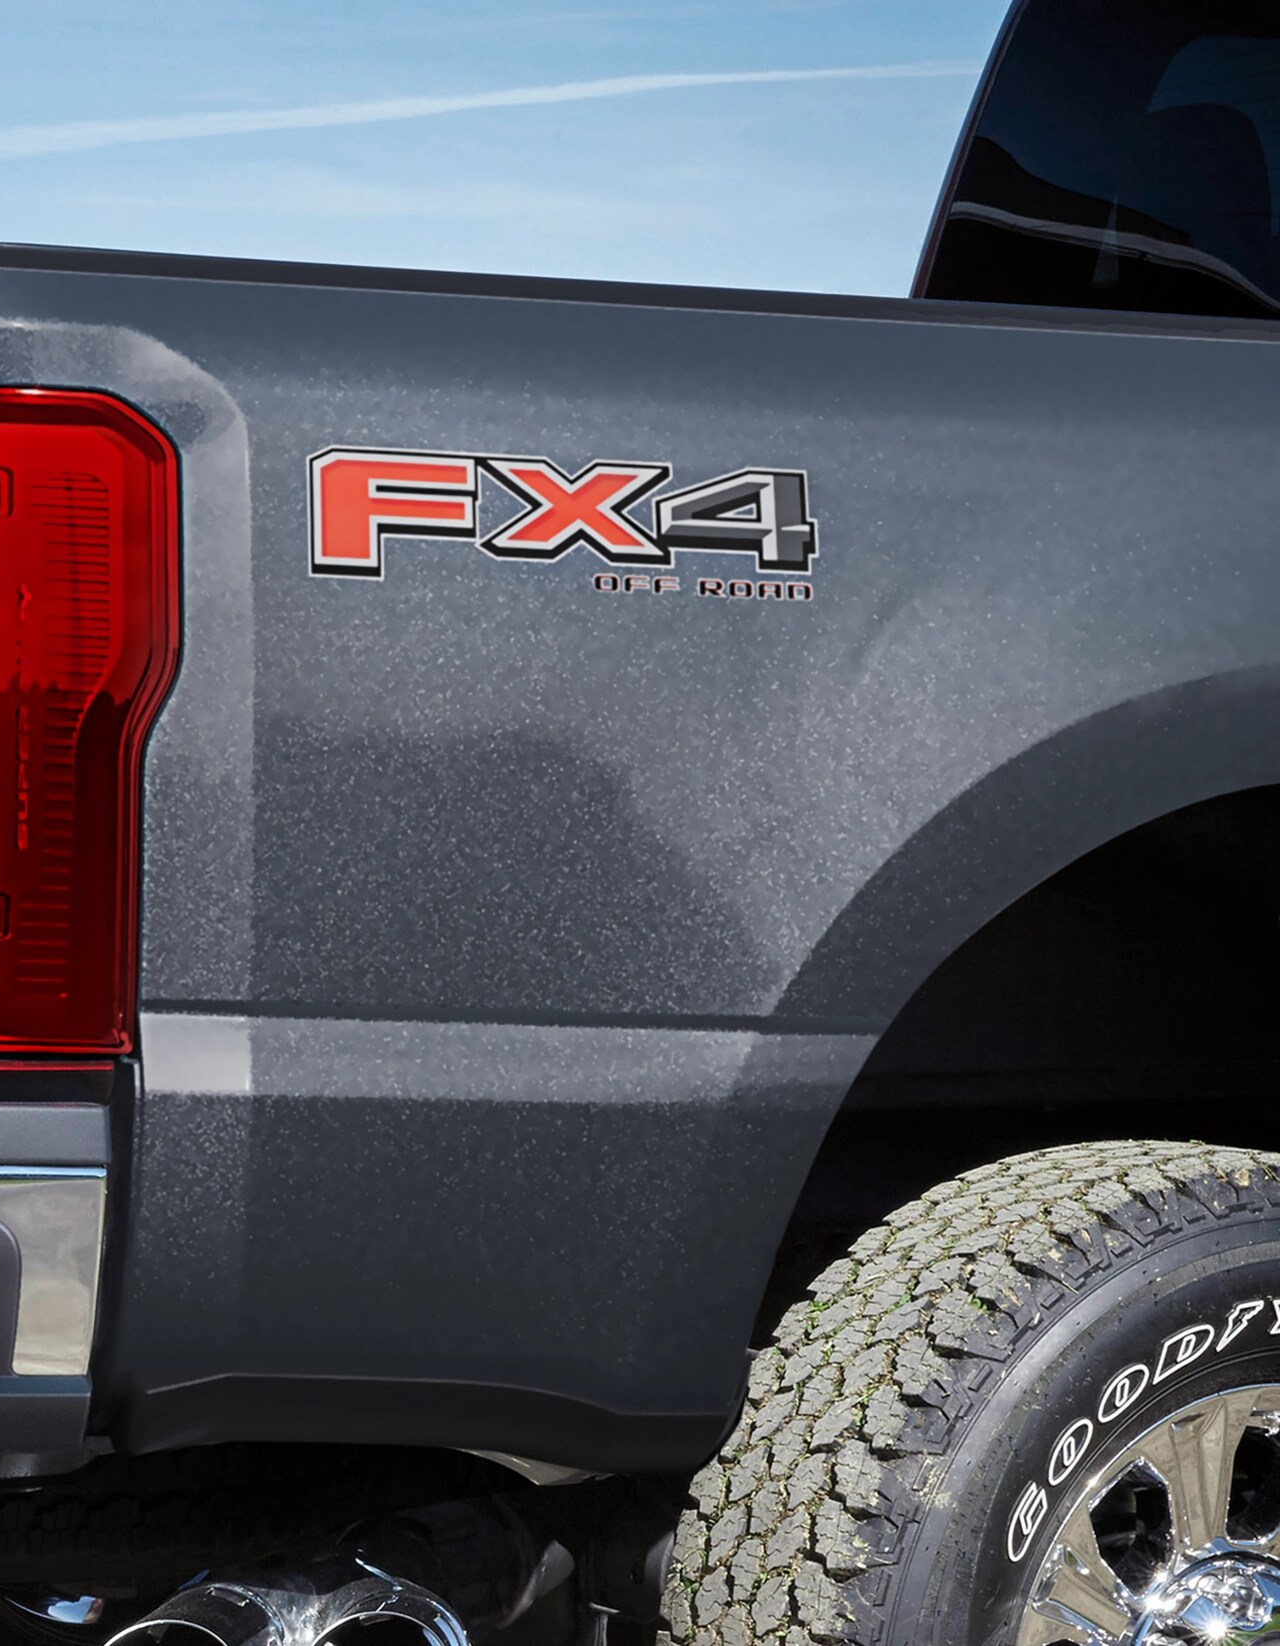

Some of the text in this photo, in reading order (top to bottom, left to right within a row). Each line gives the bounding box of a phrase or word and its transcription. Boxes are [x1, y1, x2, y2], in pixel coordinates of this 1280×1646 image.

[308, 446, 818, 579] FX4
[593, 573, 814, 600] OFF ROAD
